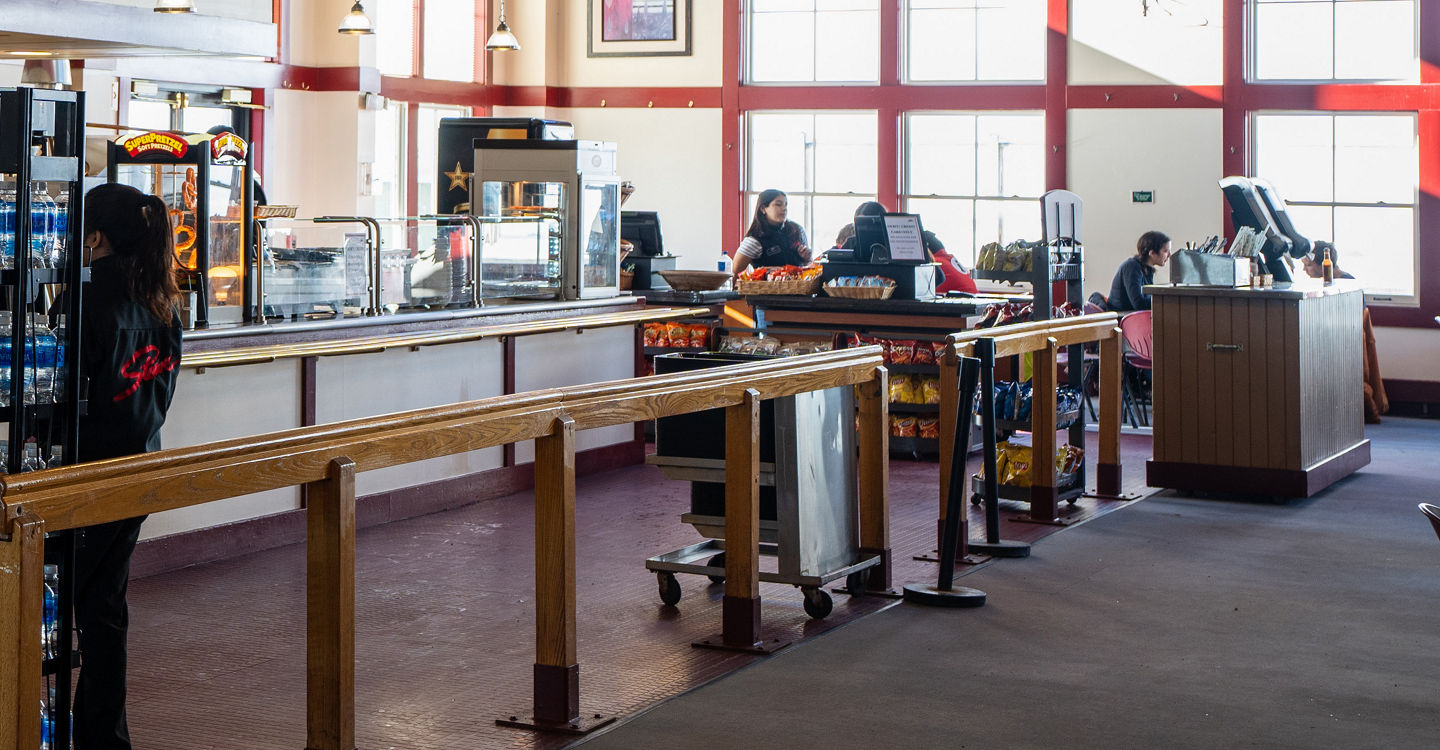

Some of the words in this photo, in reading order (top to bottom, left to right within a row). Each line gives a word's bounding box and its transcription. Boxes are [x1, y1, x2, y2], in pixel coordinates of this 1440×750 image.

[125, 132, 183, 151] SUPERPRETZEL
[137, 143, 150, 152] SOFT
[150, 142, 174, 152] PRETZELS
